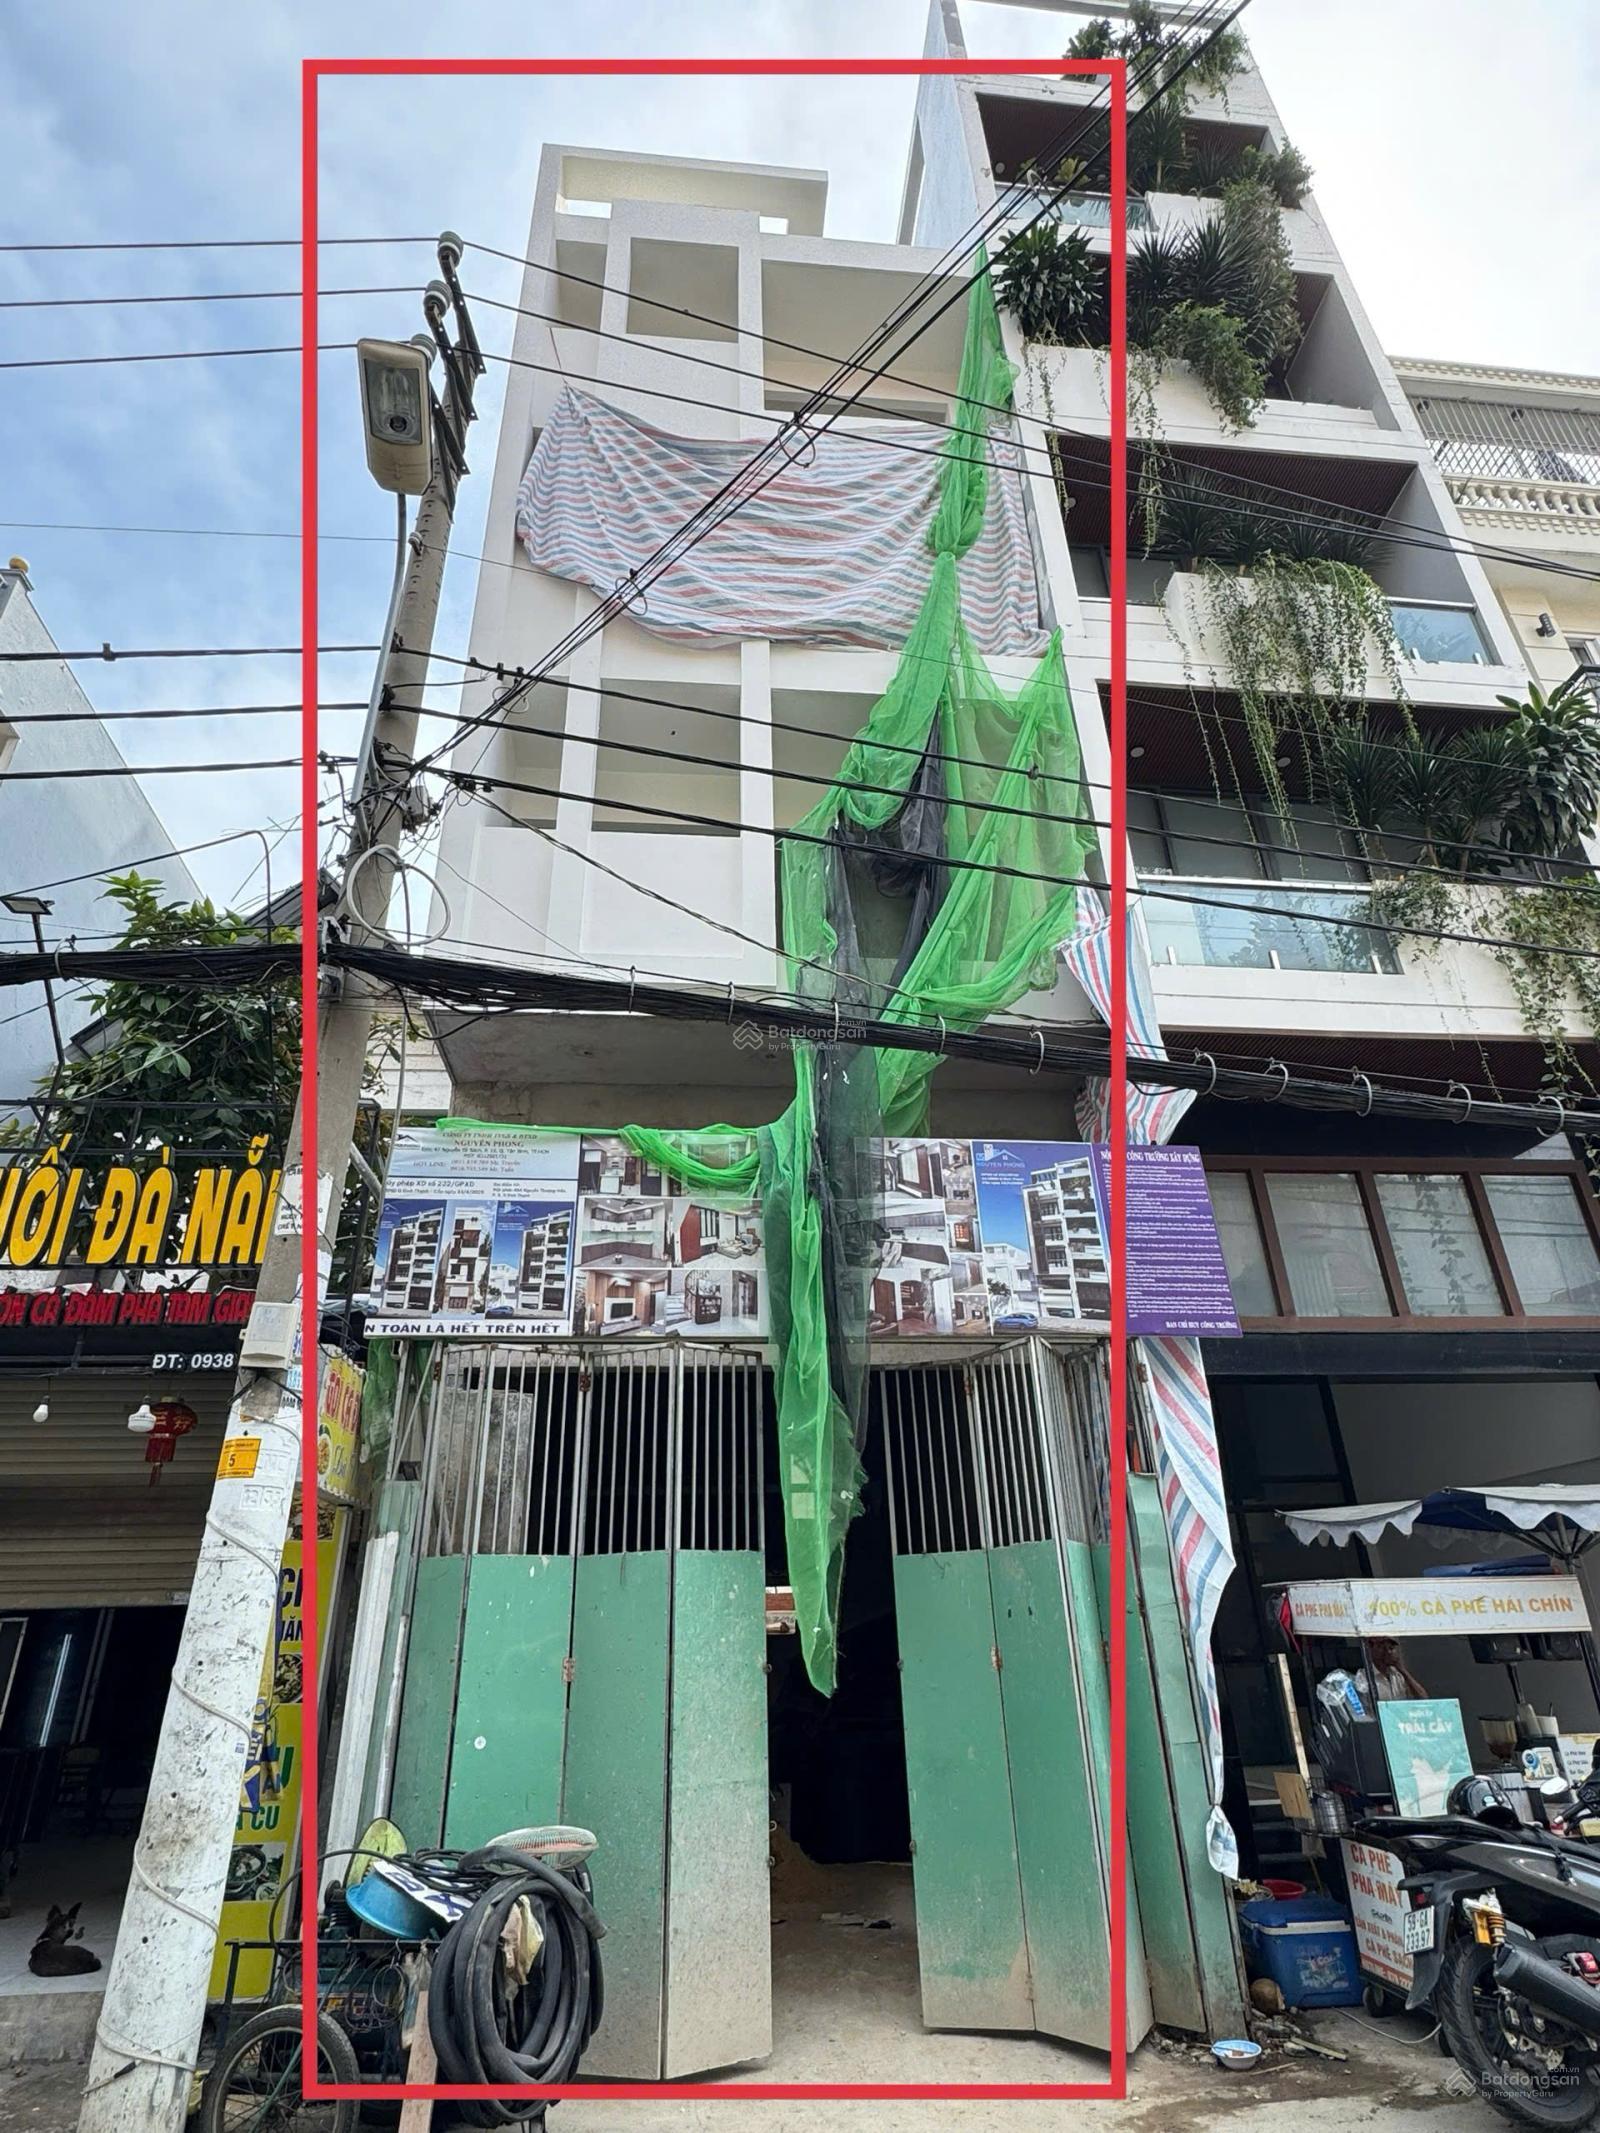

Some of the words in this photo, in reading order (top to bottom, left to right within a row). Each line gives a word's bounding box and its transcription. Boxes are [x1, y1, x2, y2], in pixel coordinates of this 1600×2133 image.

[214, 1291, 256, 1324] GIA
[380, 1321, 421, 1333] TOÀN
[426, 1321, 447, 1333] LÀ
[486, 1322, 526, 1334] TRÊN
[152, 1353, 183, 1369] ĐT:
[190, 1353, 235, 1369] 0938
[228, 1453, 236, 1467] 5
[1528, 1593, 1573, 1613] CHÍN
